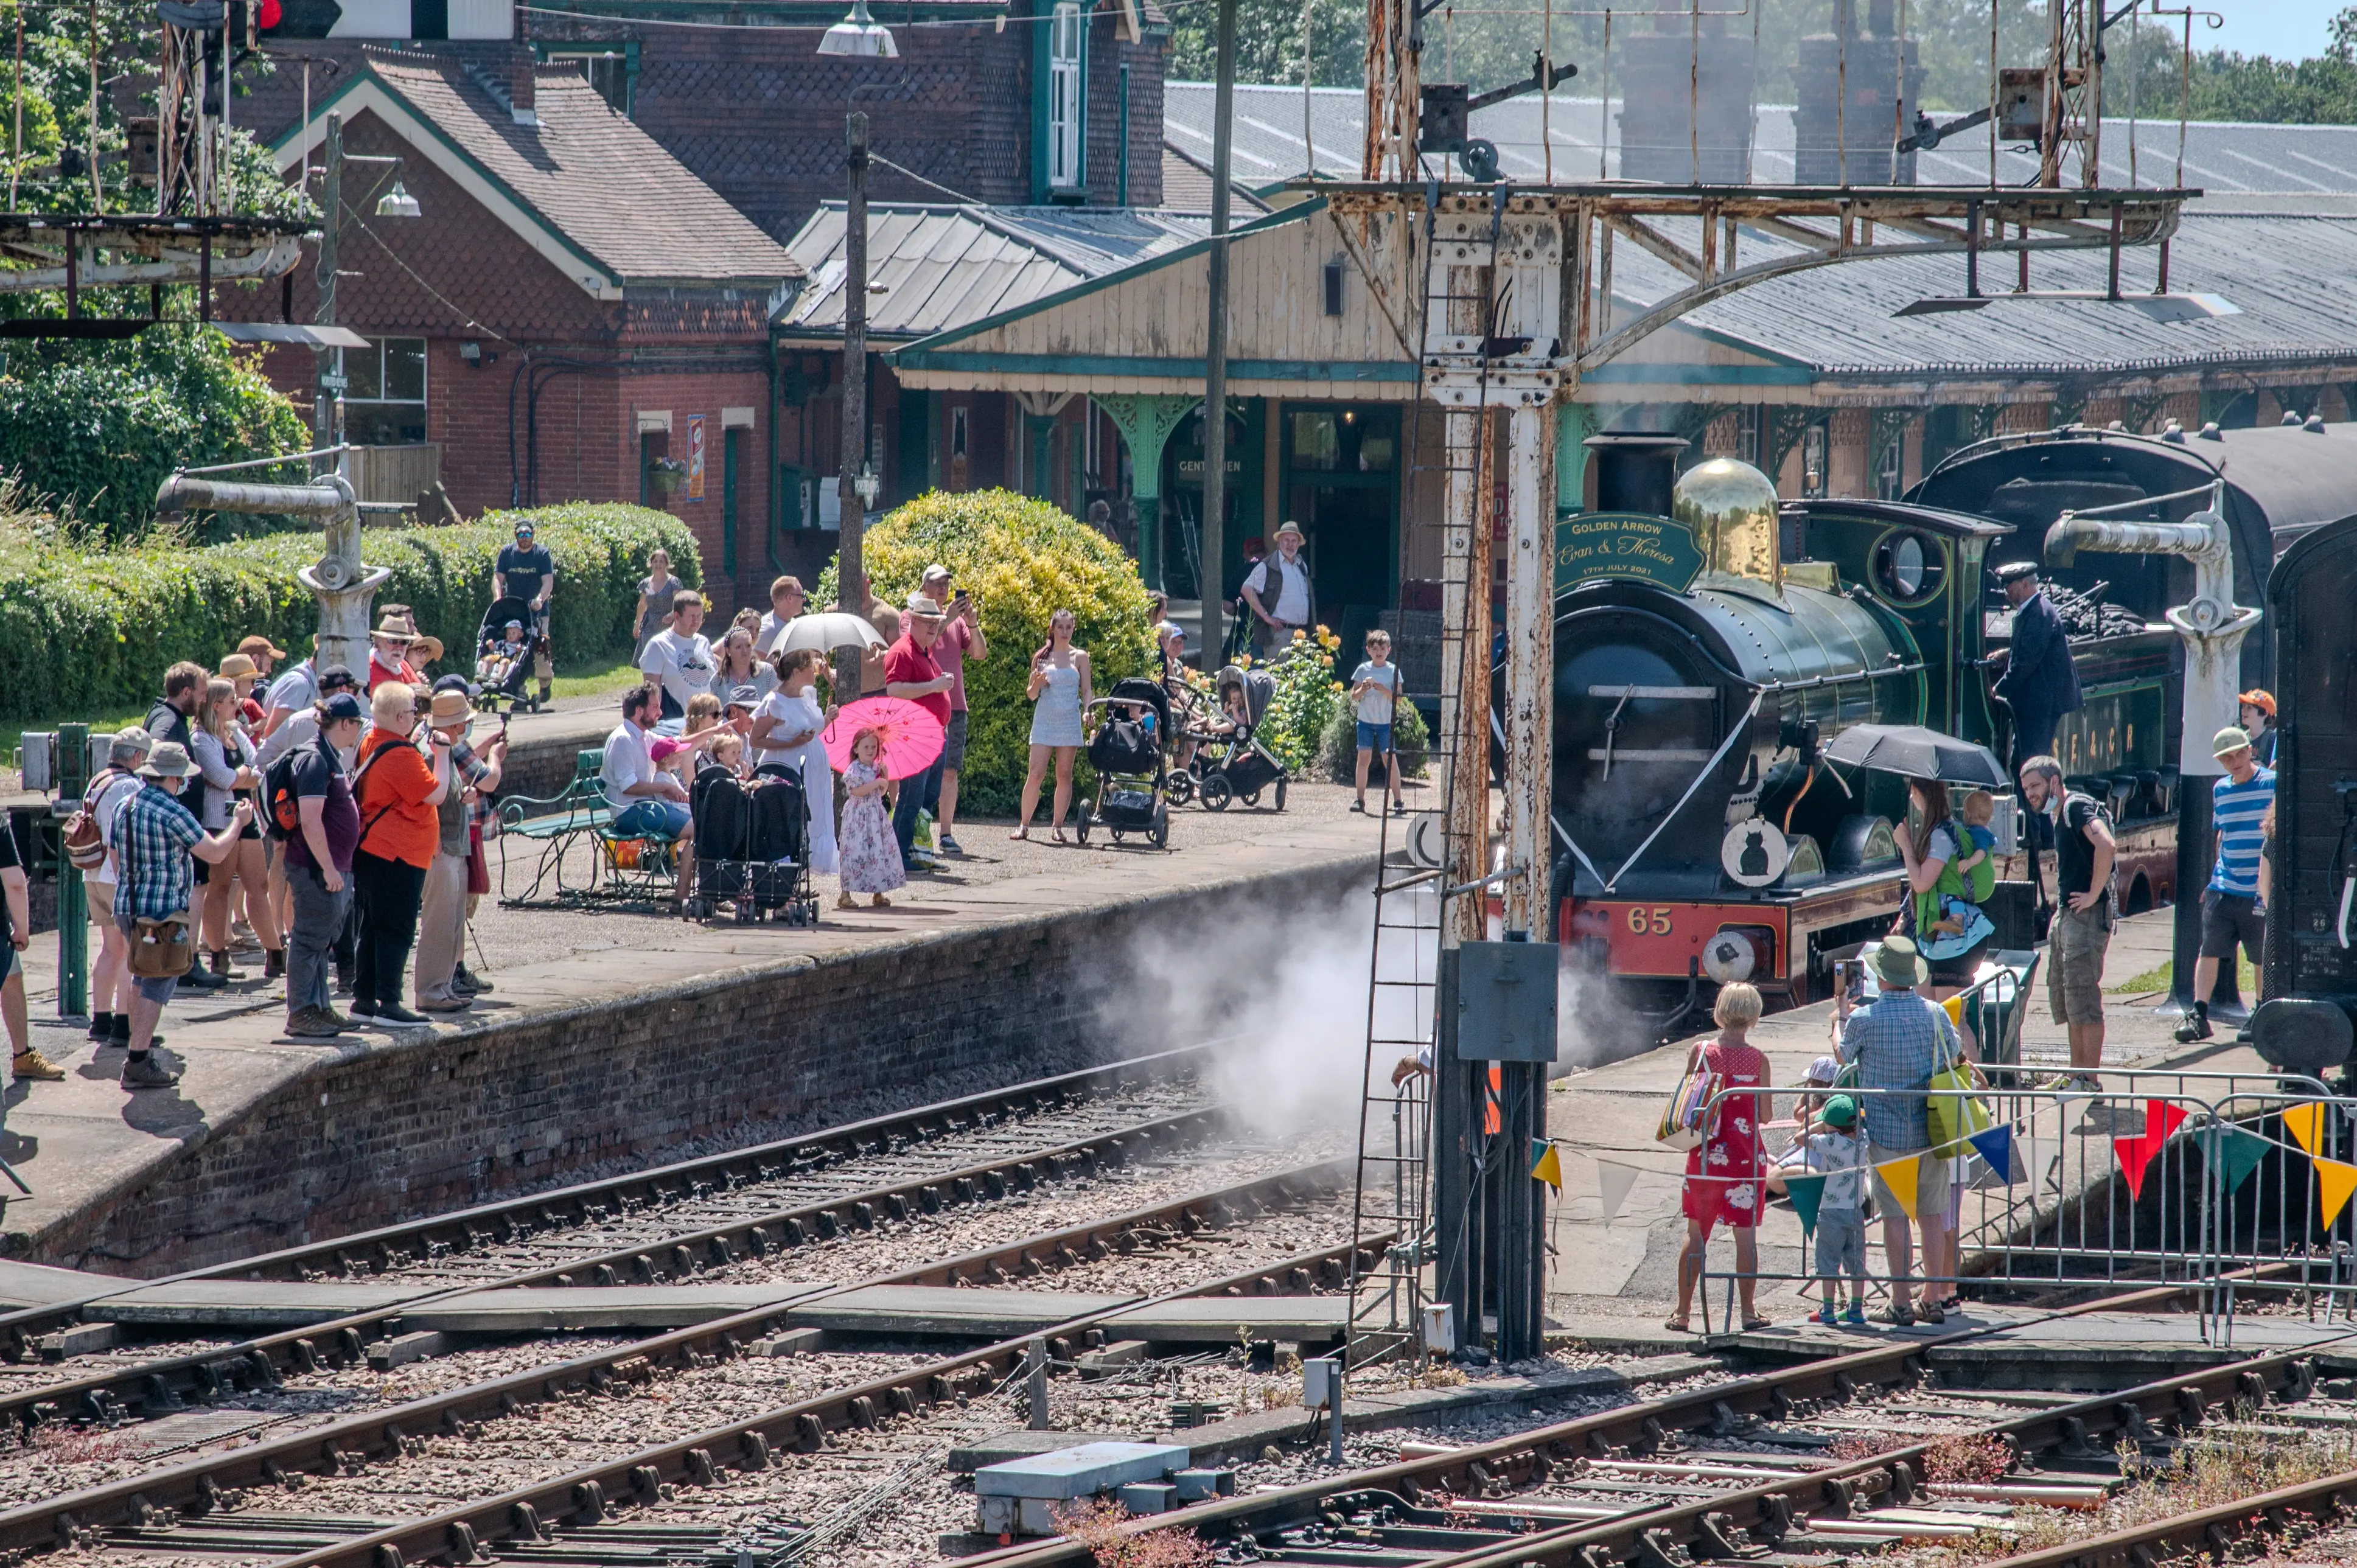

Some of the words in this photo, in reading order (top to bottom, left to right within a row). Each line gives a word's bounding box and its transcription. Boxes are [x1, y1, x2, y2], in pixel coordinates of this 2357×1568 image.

[1179, 461, 1240, 472] GENTEN
[1572, 521, 1618, 535] GOLDEN
[1622, 520, 1663, 535] ARROW
[1557, 545, 1594, 565] Evan
[1598, 538, 1613, 554] &
[1618, 535, 1675, 565] Theresa
[1583, 566, 1604, 575] 17TH
[1630, 565, 1651, 576] 2021
[1627, 907, 1672, 936] 65
